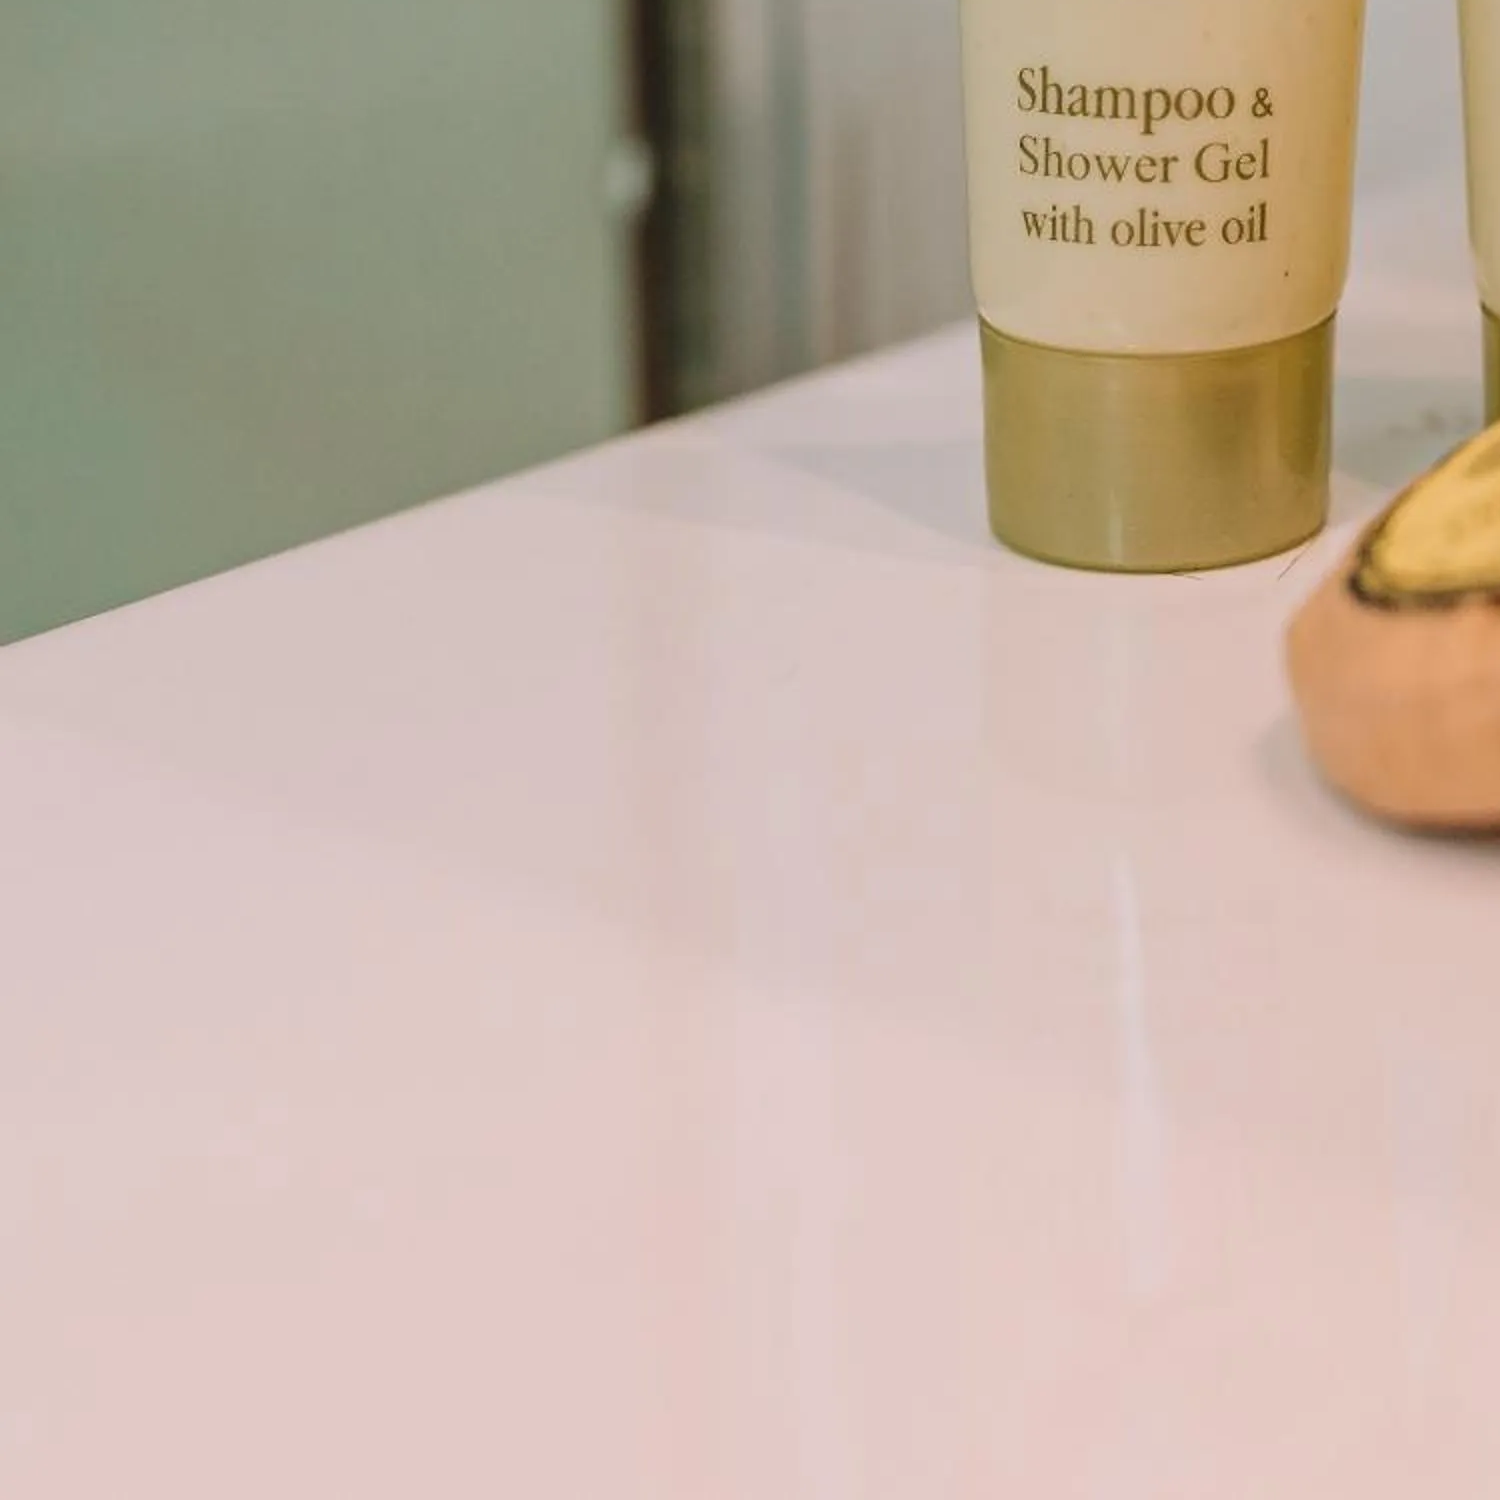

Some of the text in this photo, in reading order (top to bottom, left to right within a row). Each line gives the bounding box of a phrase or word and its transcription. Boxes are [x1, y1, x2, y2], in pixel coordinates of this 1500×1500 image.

[1016, 65, 1274, 136] Shampoo &
[1017, 133, 1270, 183] Shower Gel
[1021, 202, 1269, 248] with olive oil
